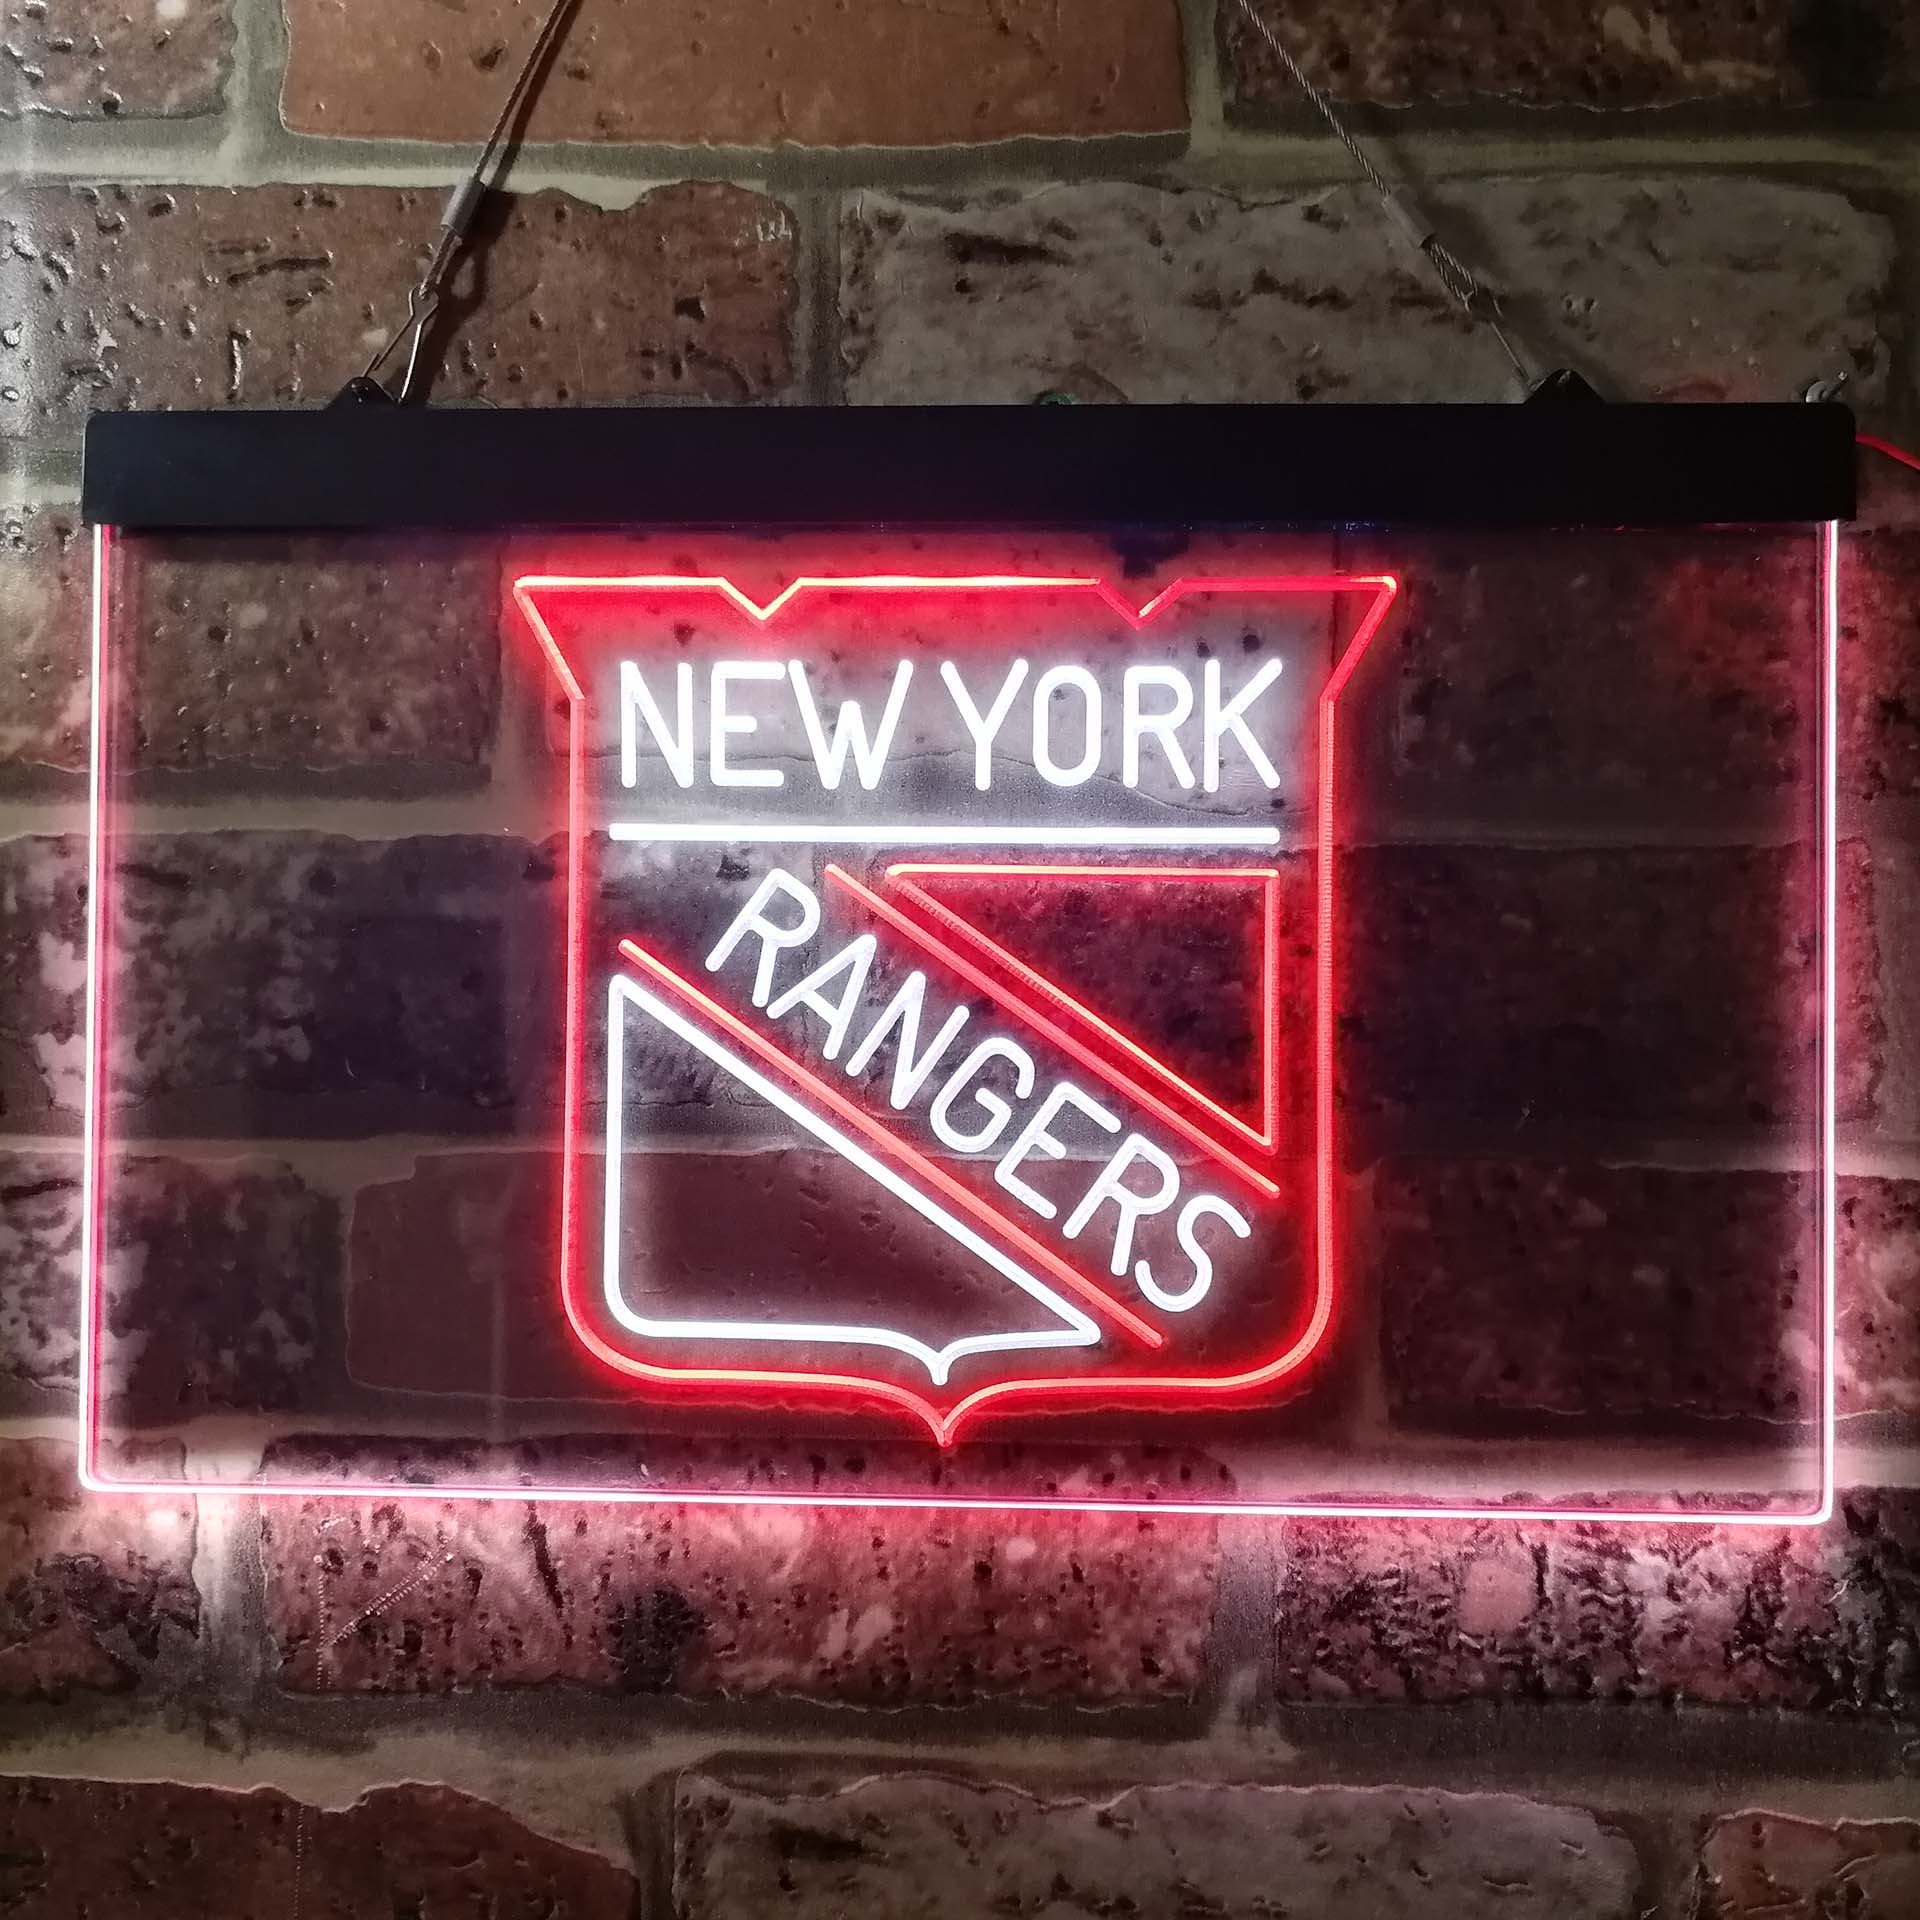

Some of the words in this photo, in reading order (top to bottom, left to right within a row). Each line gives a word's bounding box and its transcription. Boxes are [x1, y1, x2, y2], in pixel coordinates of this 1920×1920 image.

[618, 658, 914, 791] NEW
[939, 658, 1284, 793] YORK
[704, 867, 1252, 1313] RANGERS
